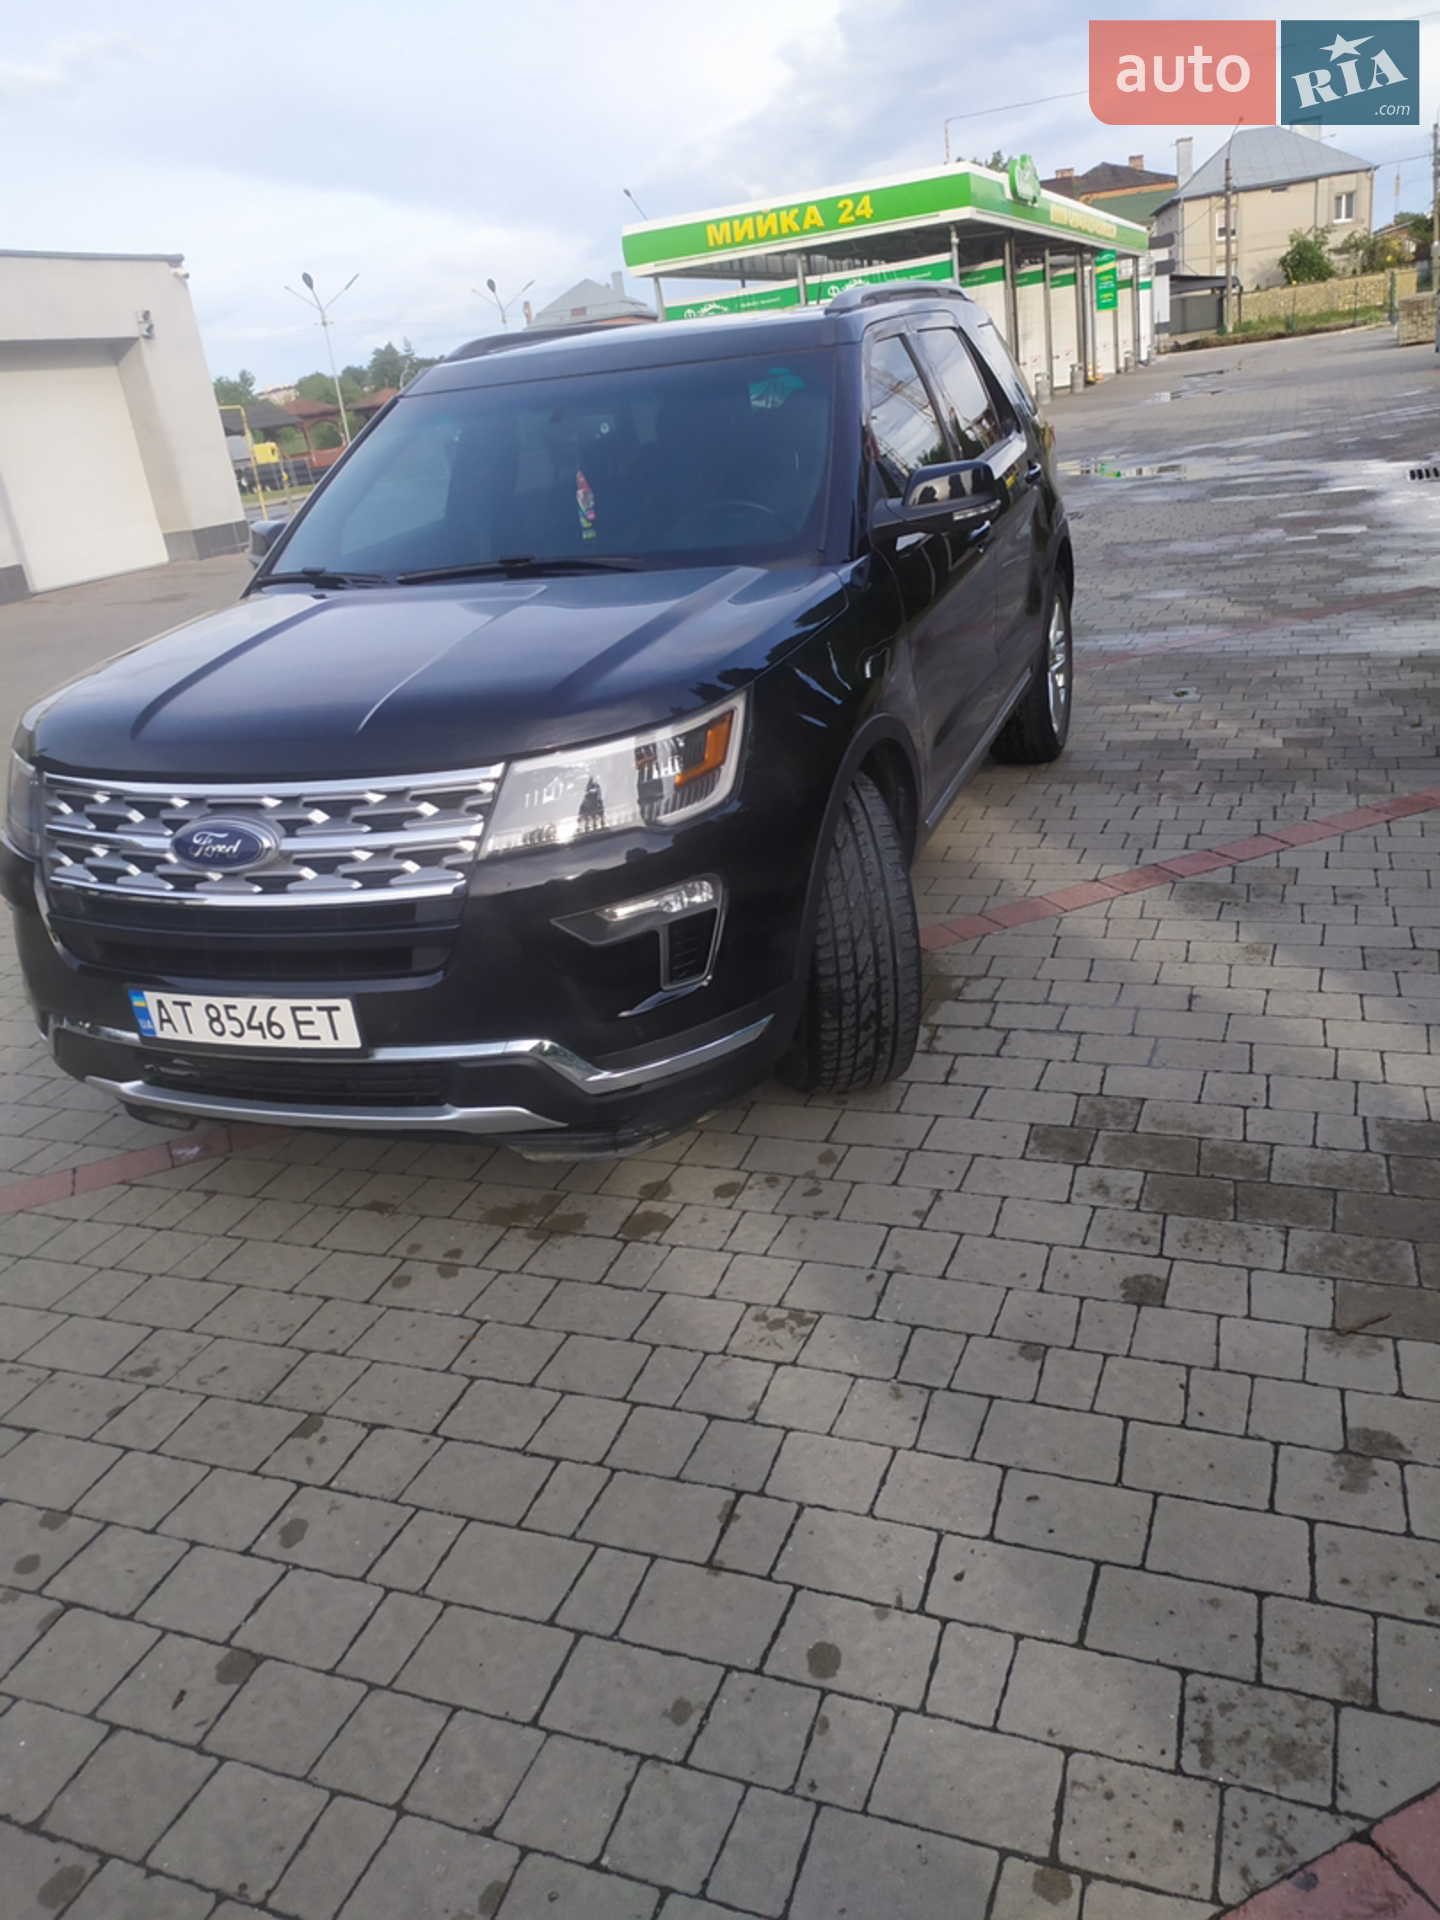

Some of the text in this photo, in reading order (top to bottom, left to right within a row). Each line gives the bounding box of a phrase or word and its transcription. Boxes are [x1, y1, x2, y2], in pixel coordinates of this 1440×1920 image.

[705, 195, 874, 248] МИЙКА 24
[188, 831, 242, 858] Ford
[155, 998, 341, 1041] AT 8546 ET
